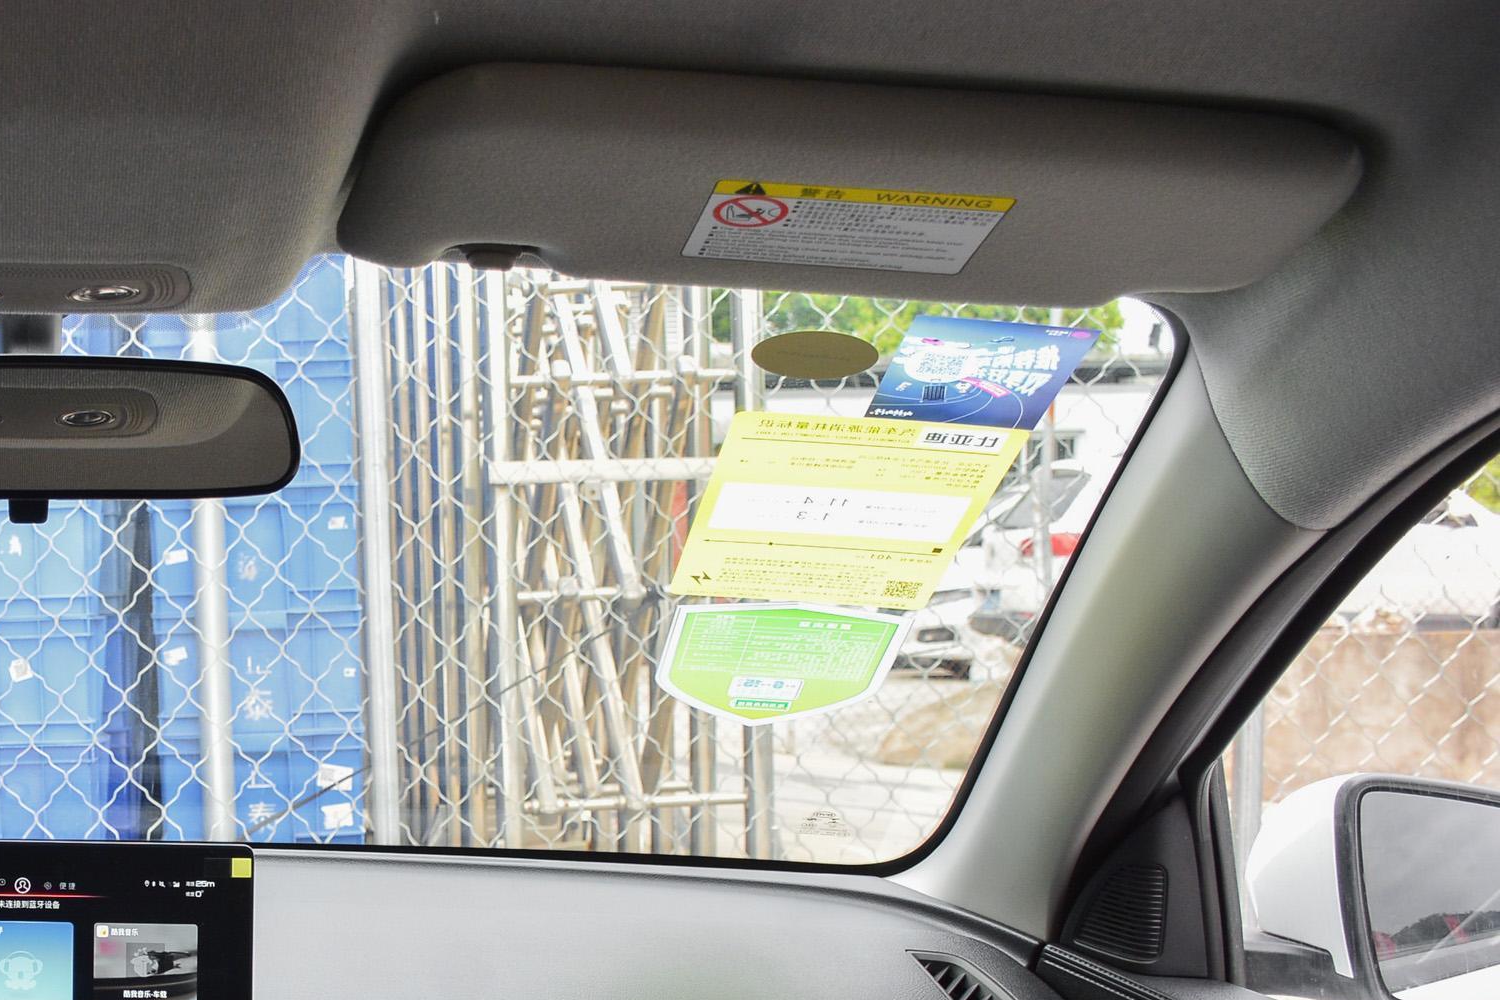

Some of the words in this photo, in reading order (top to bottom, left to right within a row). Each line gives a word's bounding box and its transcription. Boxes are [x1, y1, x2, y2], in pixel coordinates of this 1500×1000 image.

[801, 187, 846, 200] 警告
[876, 193, 993, 209] WARNING
[59, 882, 76, 891] 便捷
[110, 928, 139, 937] 酷我音乐
[123, 990, 168, 999] 酷我音乐-车载
